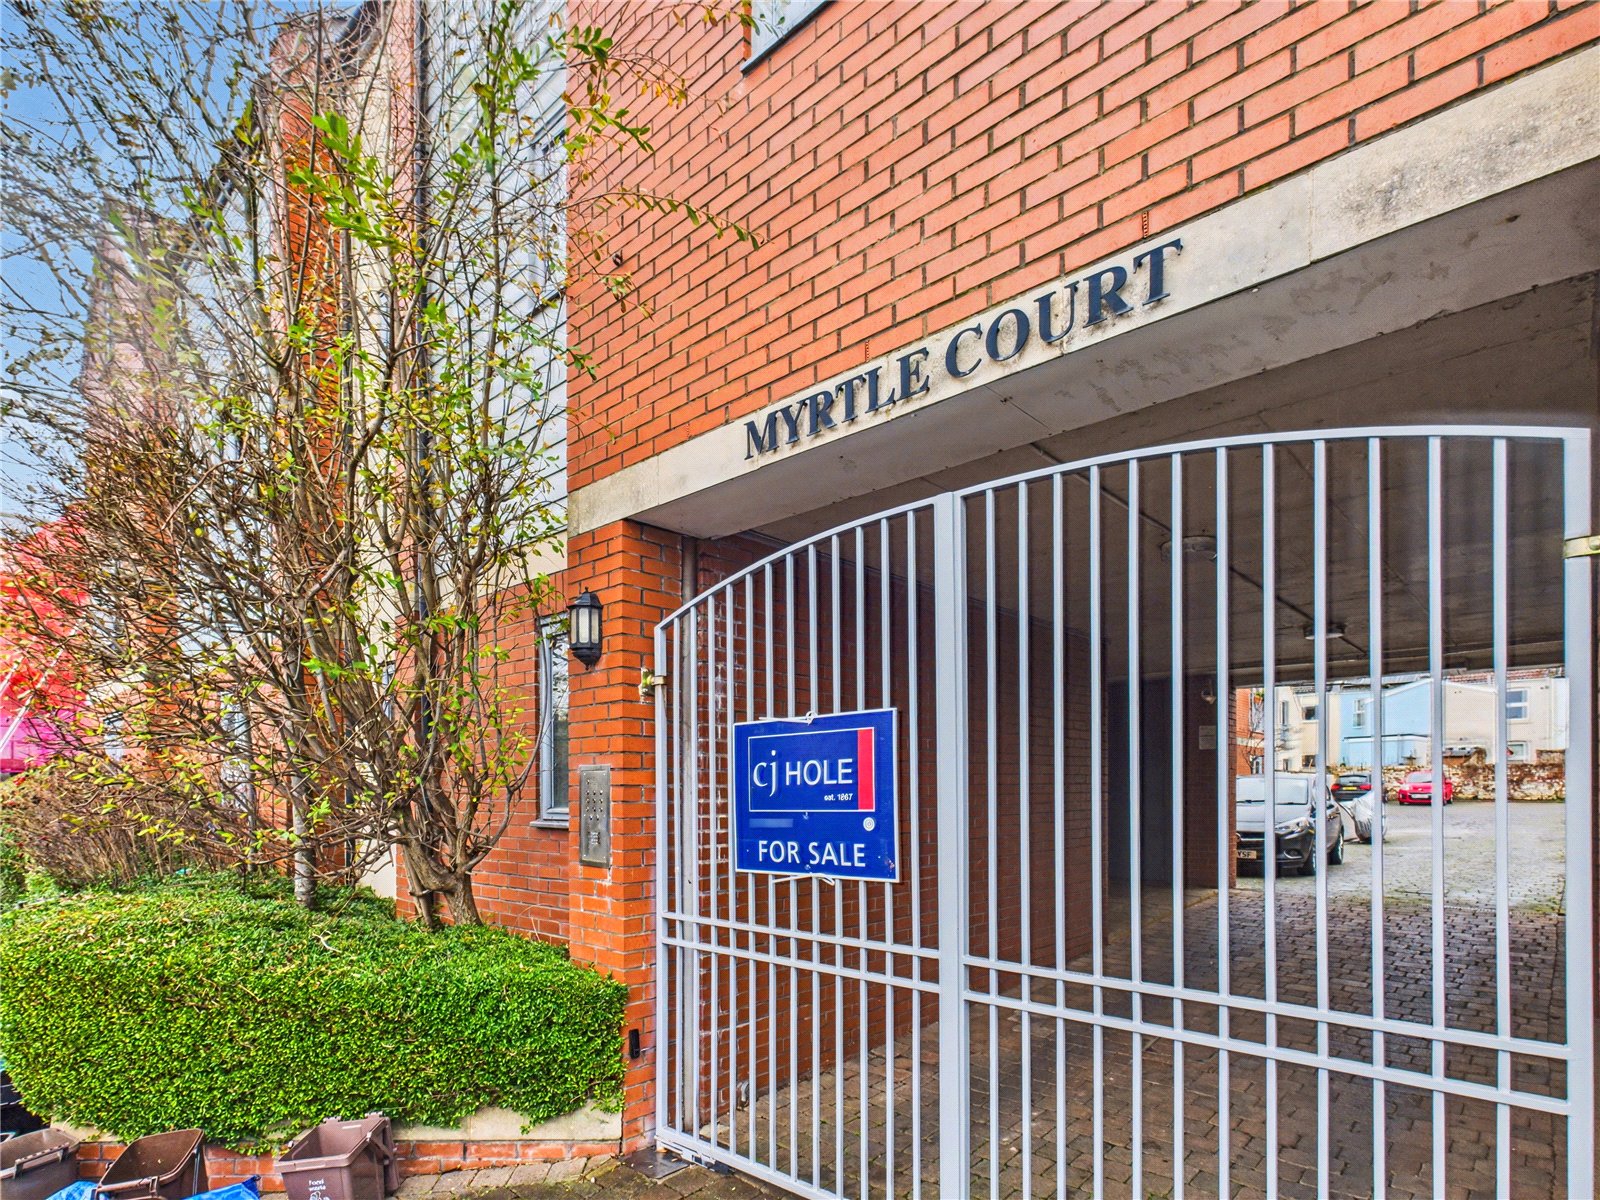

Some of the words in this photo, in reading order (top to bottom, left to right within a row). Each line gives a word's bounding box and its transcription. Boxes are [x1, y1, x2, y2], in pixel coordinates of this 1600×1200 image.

[744, 347, 930, 460] MYRTLE
[945, 238, 1184, 378] COURT
[785, 758, 853, 786] HOLE
[837, 793, 853, 801] 1867
[758, 840, 800, 864] FOR
[808, 842, 866, 867] SALE
